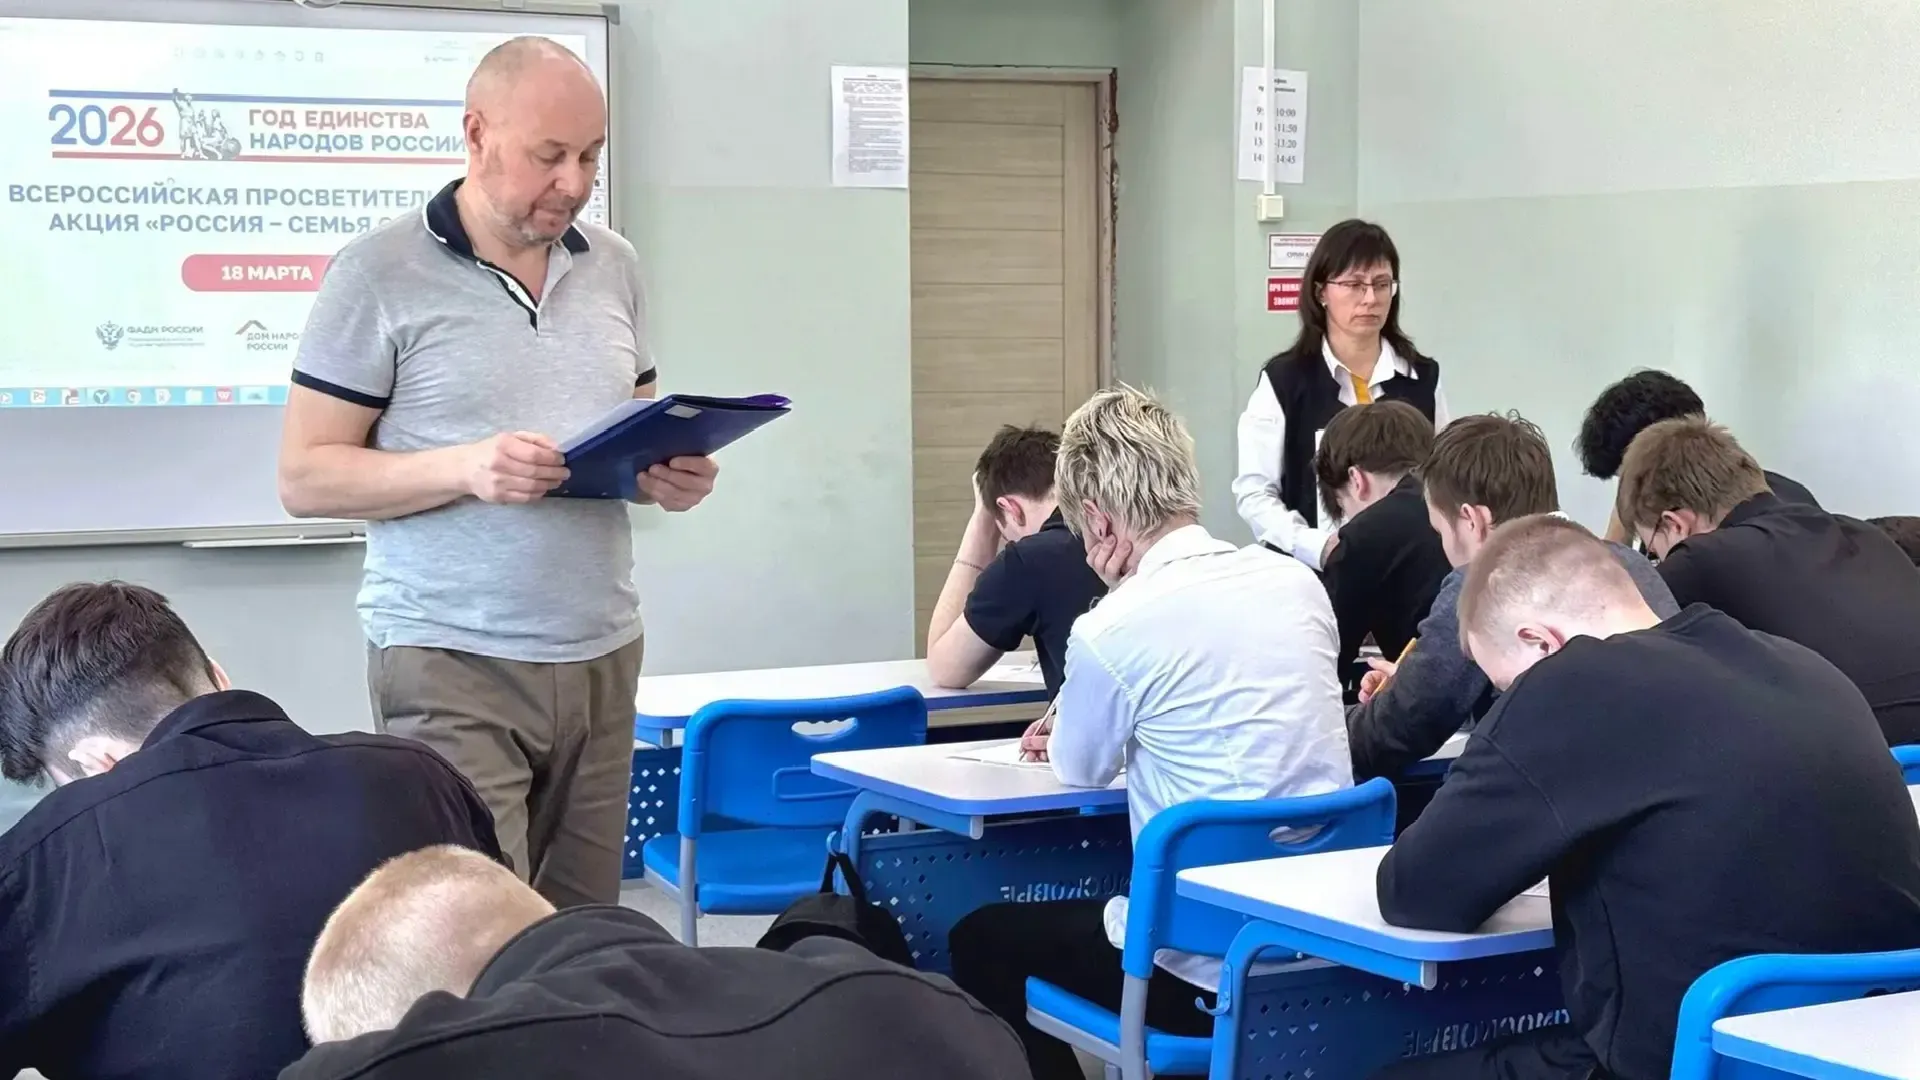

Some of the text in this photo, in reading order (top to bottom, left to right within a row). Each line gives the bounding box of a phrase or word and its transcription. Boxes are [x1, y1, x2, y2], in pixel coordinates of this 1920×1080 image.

[48, 104, 165, 147] 2026
[249, 109, 429, 130] ГОД ЕДИНСТВА
[249, 133, 466, 153] НАРОДОВ РОССИИ
[9, 181, 431, 208] ВСЕРОССИЙСКАЯ ПРОСВЕТИТЕЛ
[49, 213, 139, 234] АКЦИЯ
[146, 215, 263, 232] «РОССИЯ
[288, 216, 371, 233] СЕМЬЯ
[221, 265, 313, 281] 18 МАРТА
[1273, 296, 1299, 306] ЗВОНИТ
[161, 326, 204, 334] РОССИИ
[247, 333, 300, 341] ДОМ НАРО
[247, 342, 288, 351] РОССИИ
